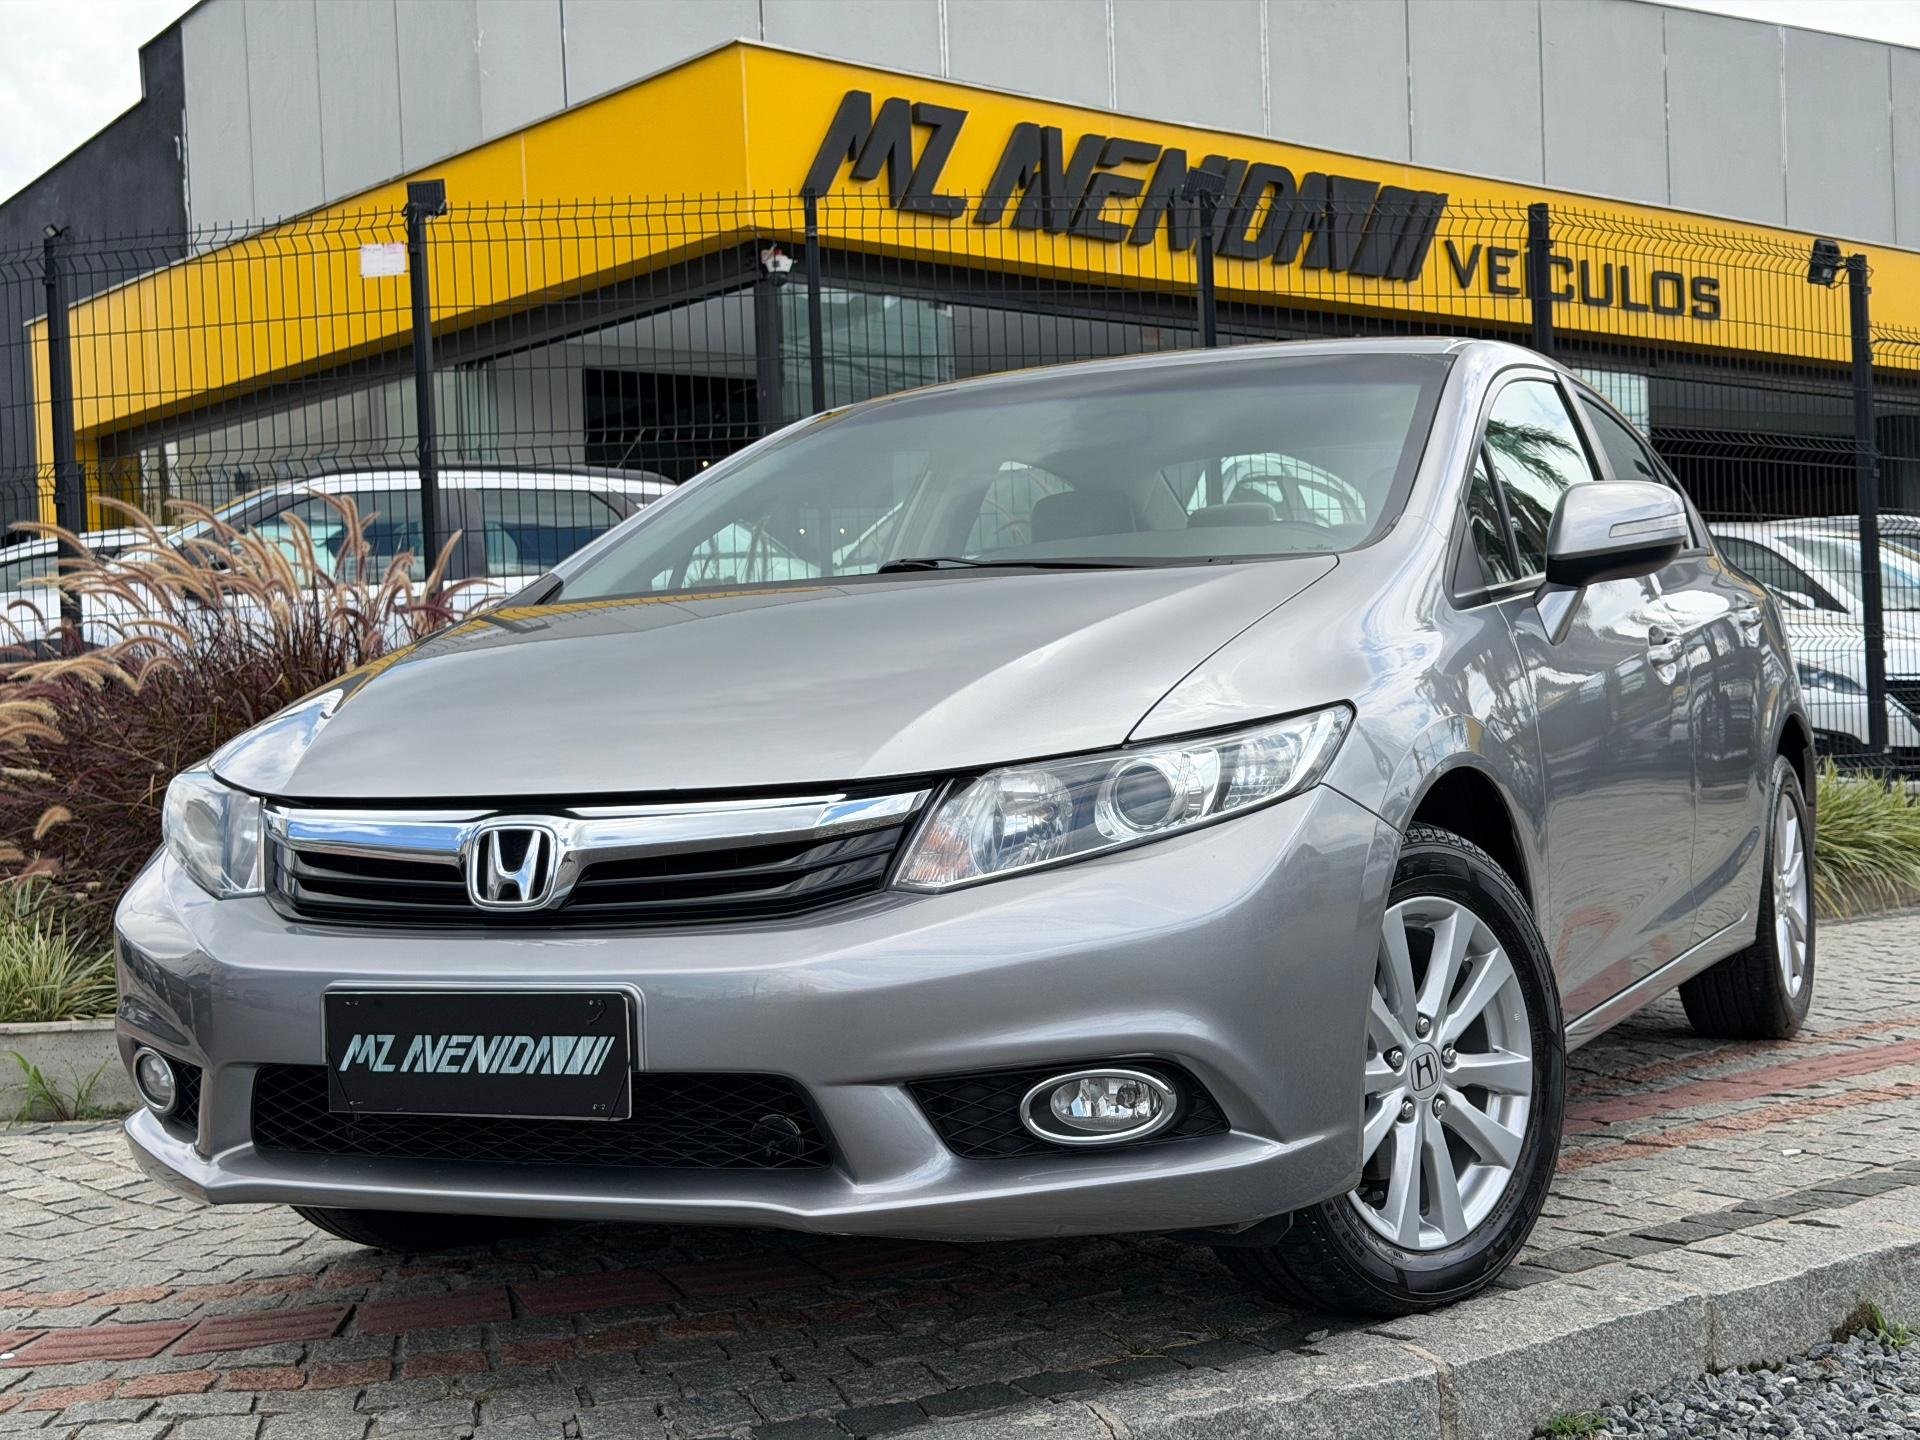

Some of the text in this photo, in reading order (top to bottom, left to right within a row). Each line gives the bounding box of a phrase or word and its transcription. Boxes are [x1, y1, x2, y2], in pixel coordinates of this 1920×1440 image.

[799, 89, 970, 220] MZ
[972, 121, 1382, 272] AVENIDA
[338, 1033, 586, 1075] MZ AVENIDA
